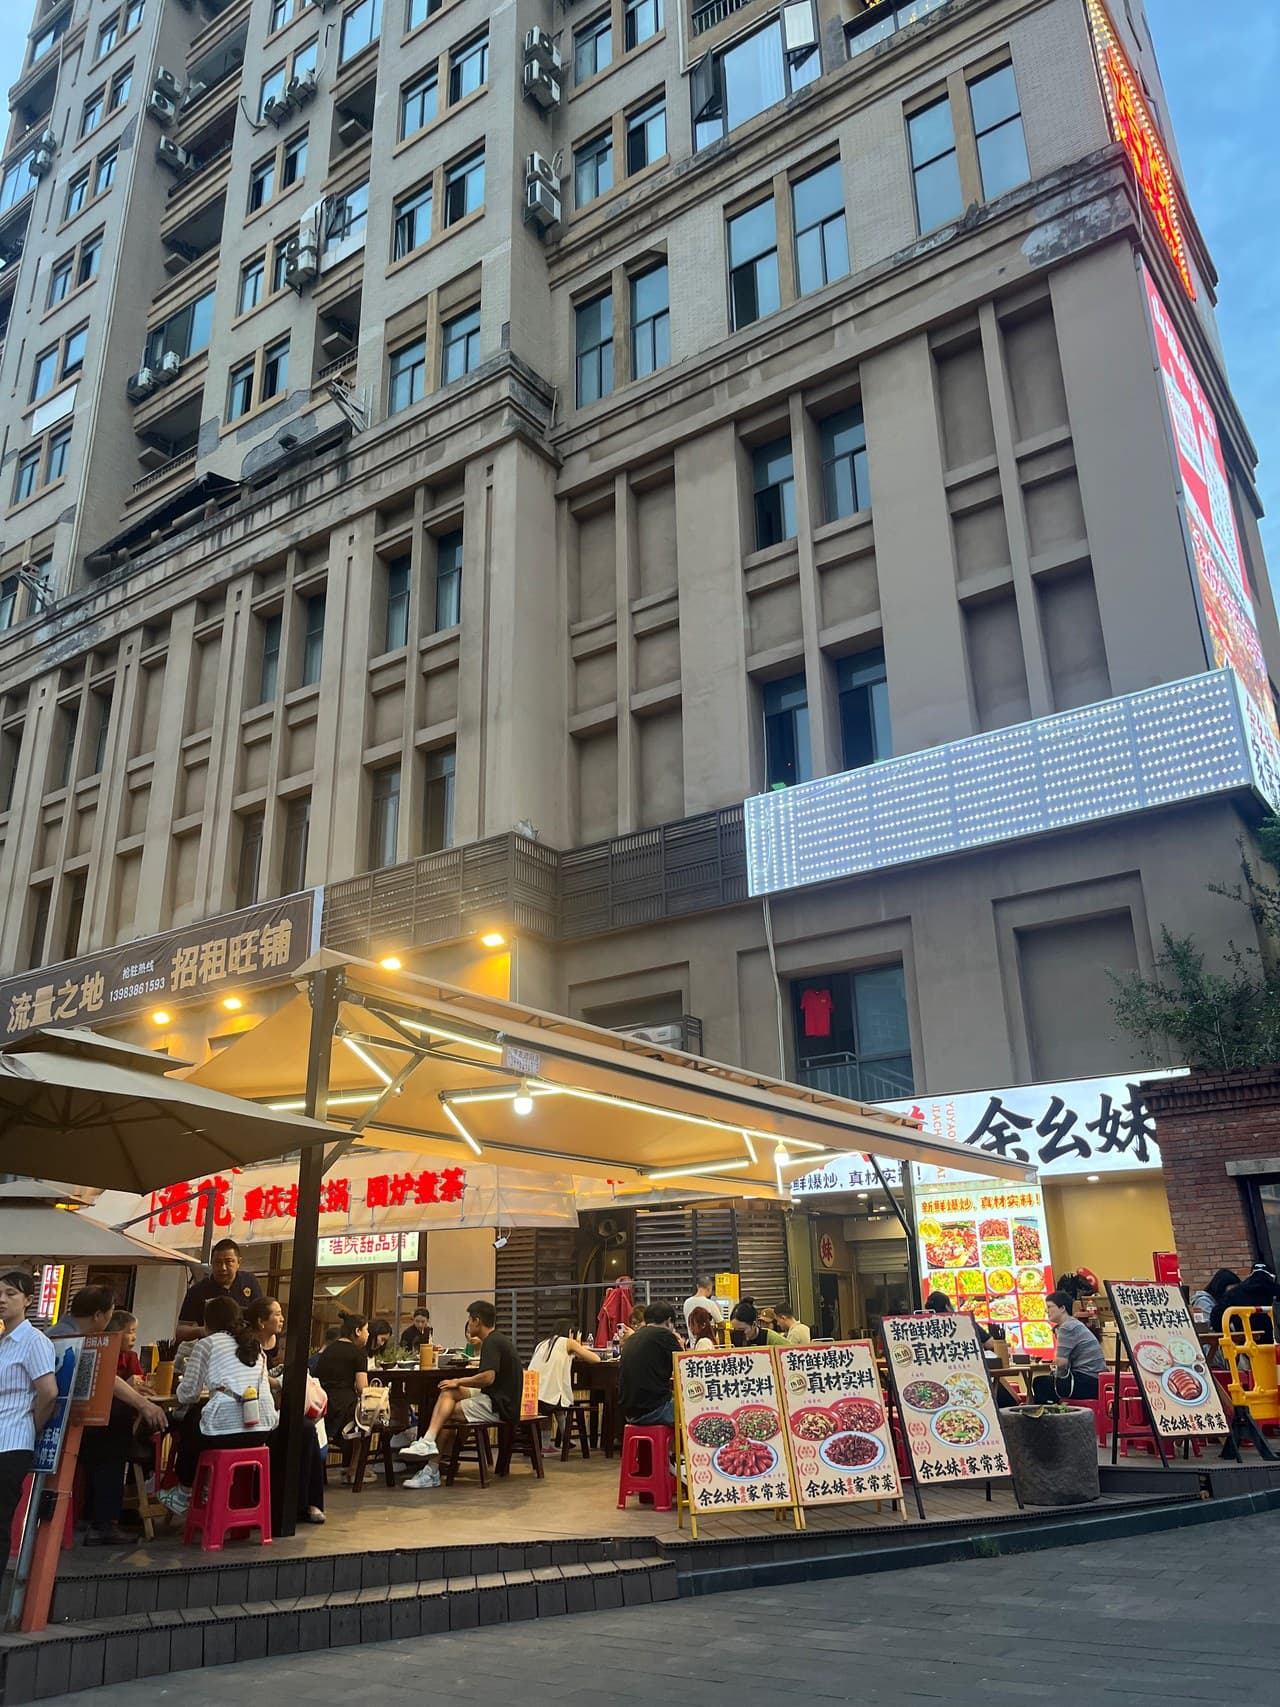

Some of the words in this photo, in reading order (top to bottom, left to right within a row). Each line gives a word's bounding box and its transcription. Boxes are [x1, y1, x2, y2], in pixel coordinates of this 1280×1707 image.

[170, 918, 293, 992] 招租旺铺
[6, 970, 105, 1034] 流量之地
[109, 977, 165, 1002] 13983861593
[962, 1083, 1158, 1163] 余幺妹
[242, 1178, 349, 1221] 重庆老锅
[366, 1167, 465, 1208] 围炉煮茶
[1116, 1286, 1169, 1306] 新鲜爆炒
[889, 1318, 957, 1341] 新鲜爆炒
[1135, 1308, 1190, 1330] 真材实料
[786, 1349, 854, 1371] 新鲜爆炒
[912, 1338, 979, 1366] 真材实料
[685, 1355, 754, 1378] 新鲜爆炒
[704, 1375, 774, 1401] 真材实料
[806, 1367, 875, 1394] 真材实料
[1159, 1414, 1191, 1432] 余幺妹
[1194, 1411, 1227, 1430] 家常菜
[919, 1457, 961, 1480] 余幺妹
[966, 1453, 1008, 1474] 家常菜
[697, 1486, 740, 1506] 余幺妹
[746, 1481, 789, 1501] 家常菜
[805, 1477, 847, 1498] 余幺妹
[853, 1473, 895, 1493] 家常菜
